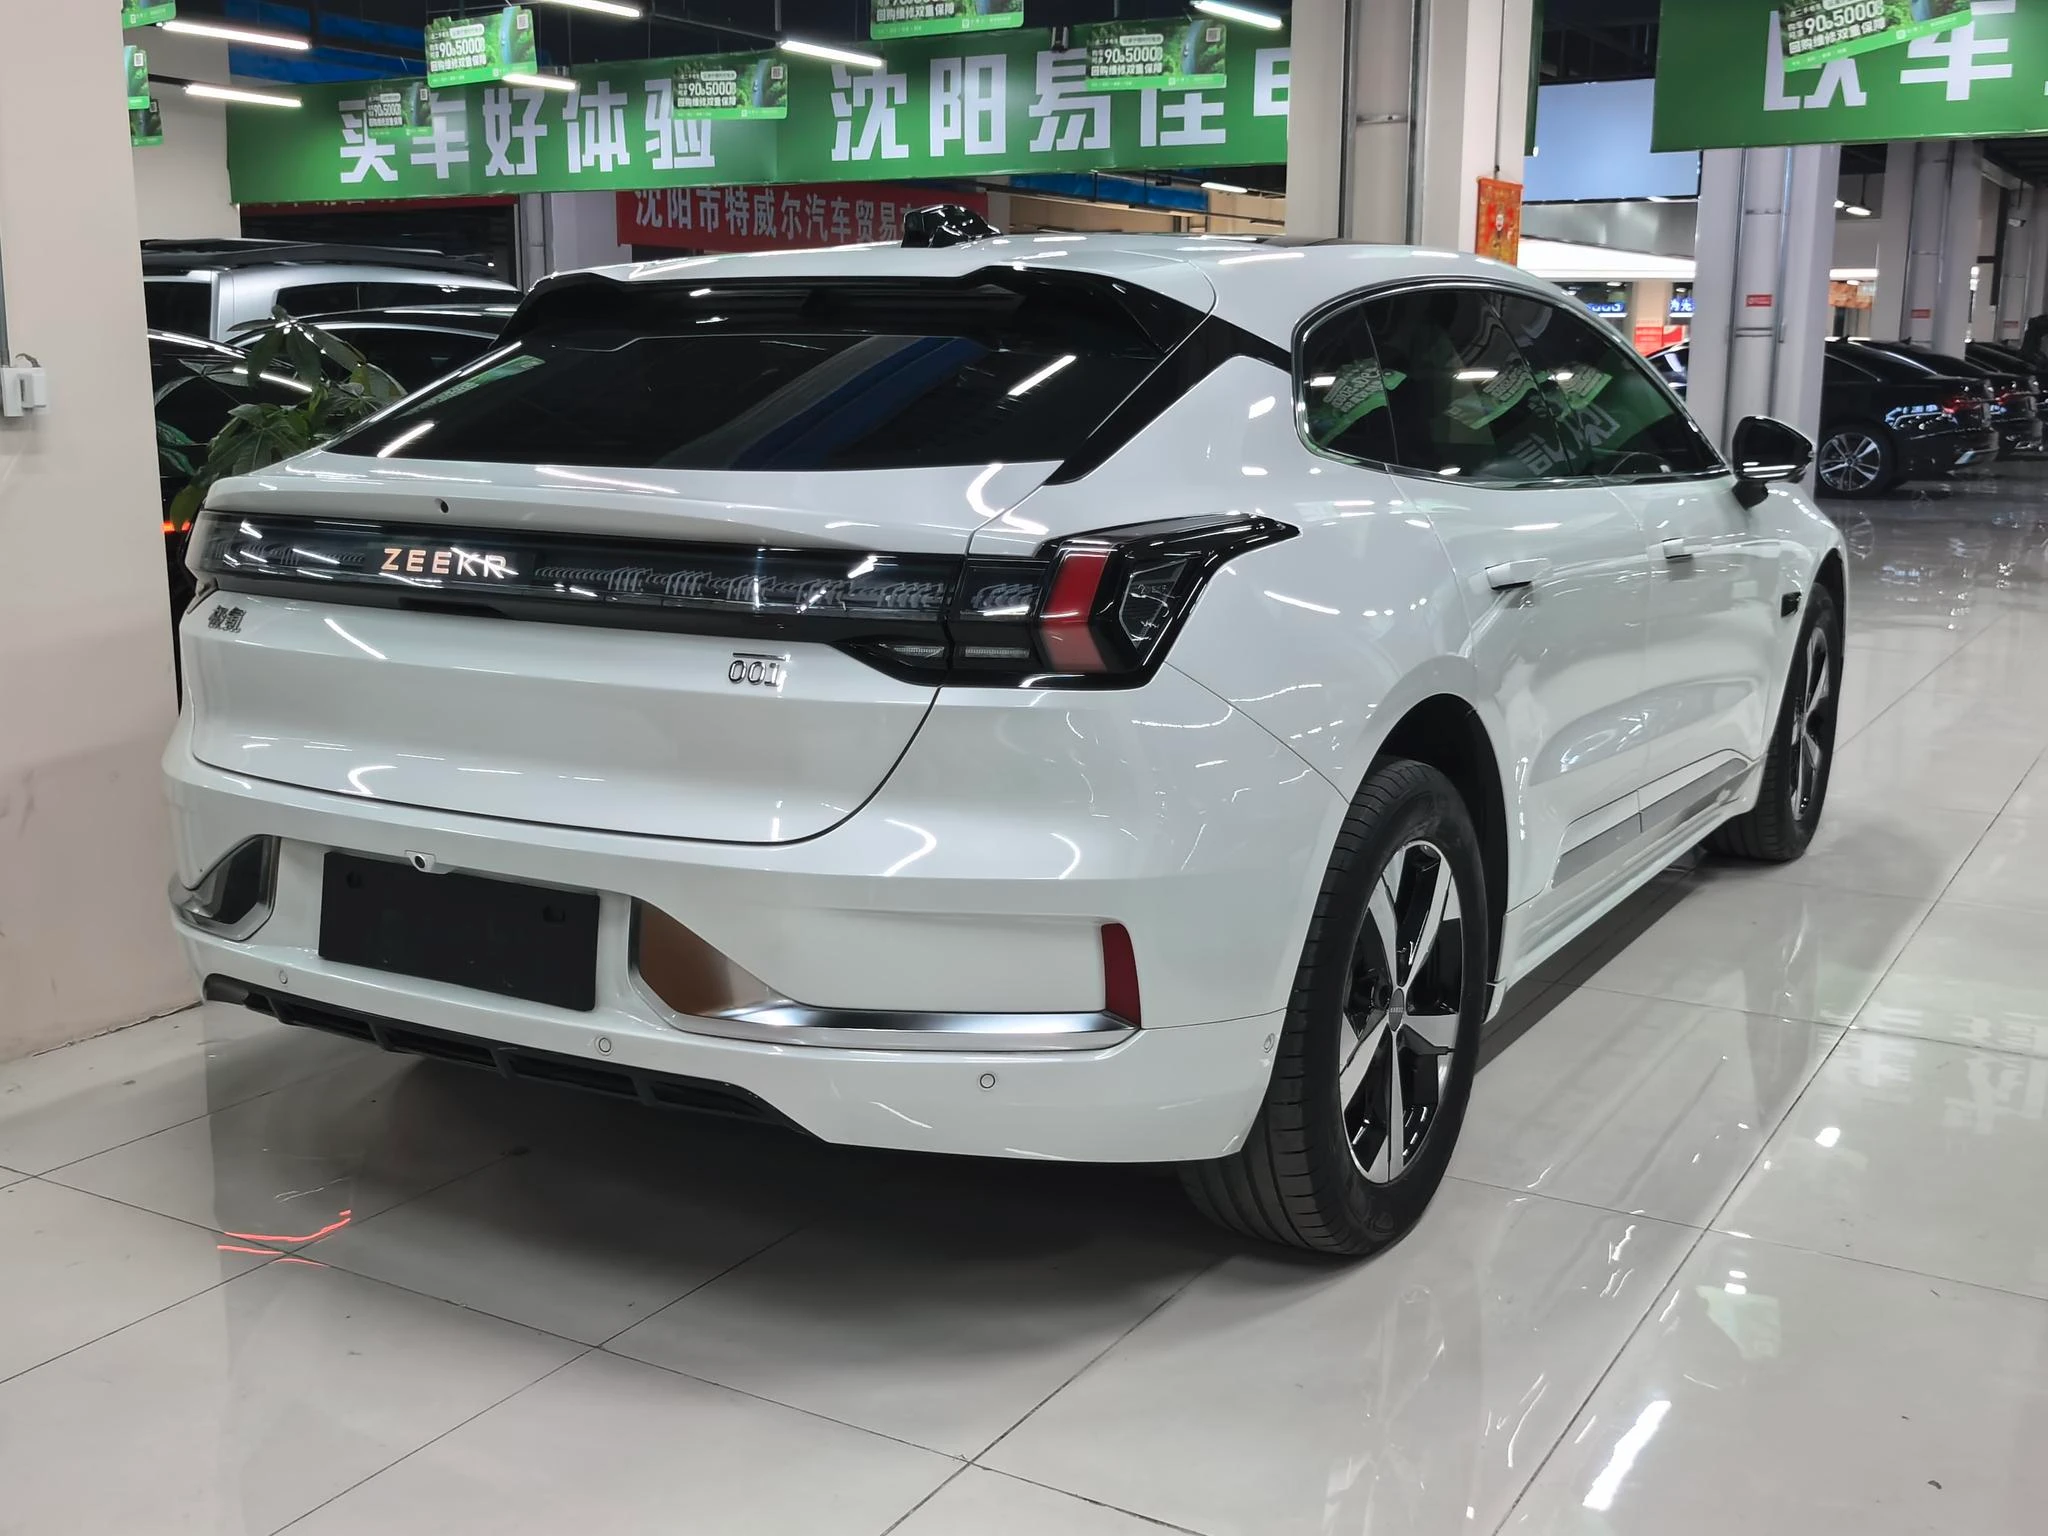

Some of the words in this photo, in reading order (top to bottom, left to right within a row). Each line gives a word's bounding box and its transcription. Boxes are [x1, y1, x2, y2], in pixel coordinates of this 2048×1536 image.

[339, 78, 716, 184] 买车好体验
[634, 186, 913, 244] 沈阳市特威尔汽车贸易
[381, 547, 507, 579] ZEEKR
[728, 655, 782, 689] 001
